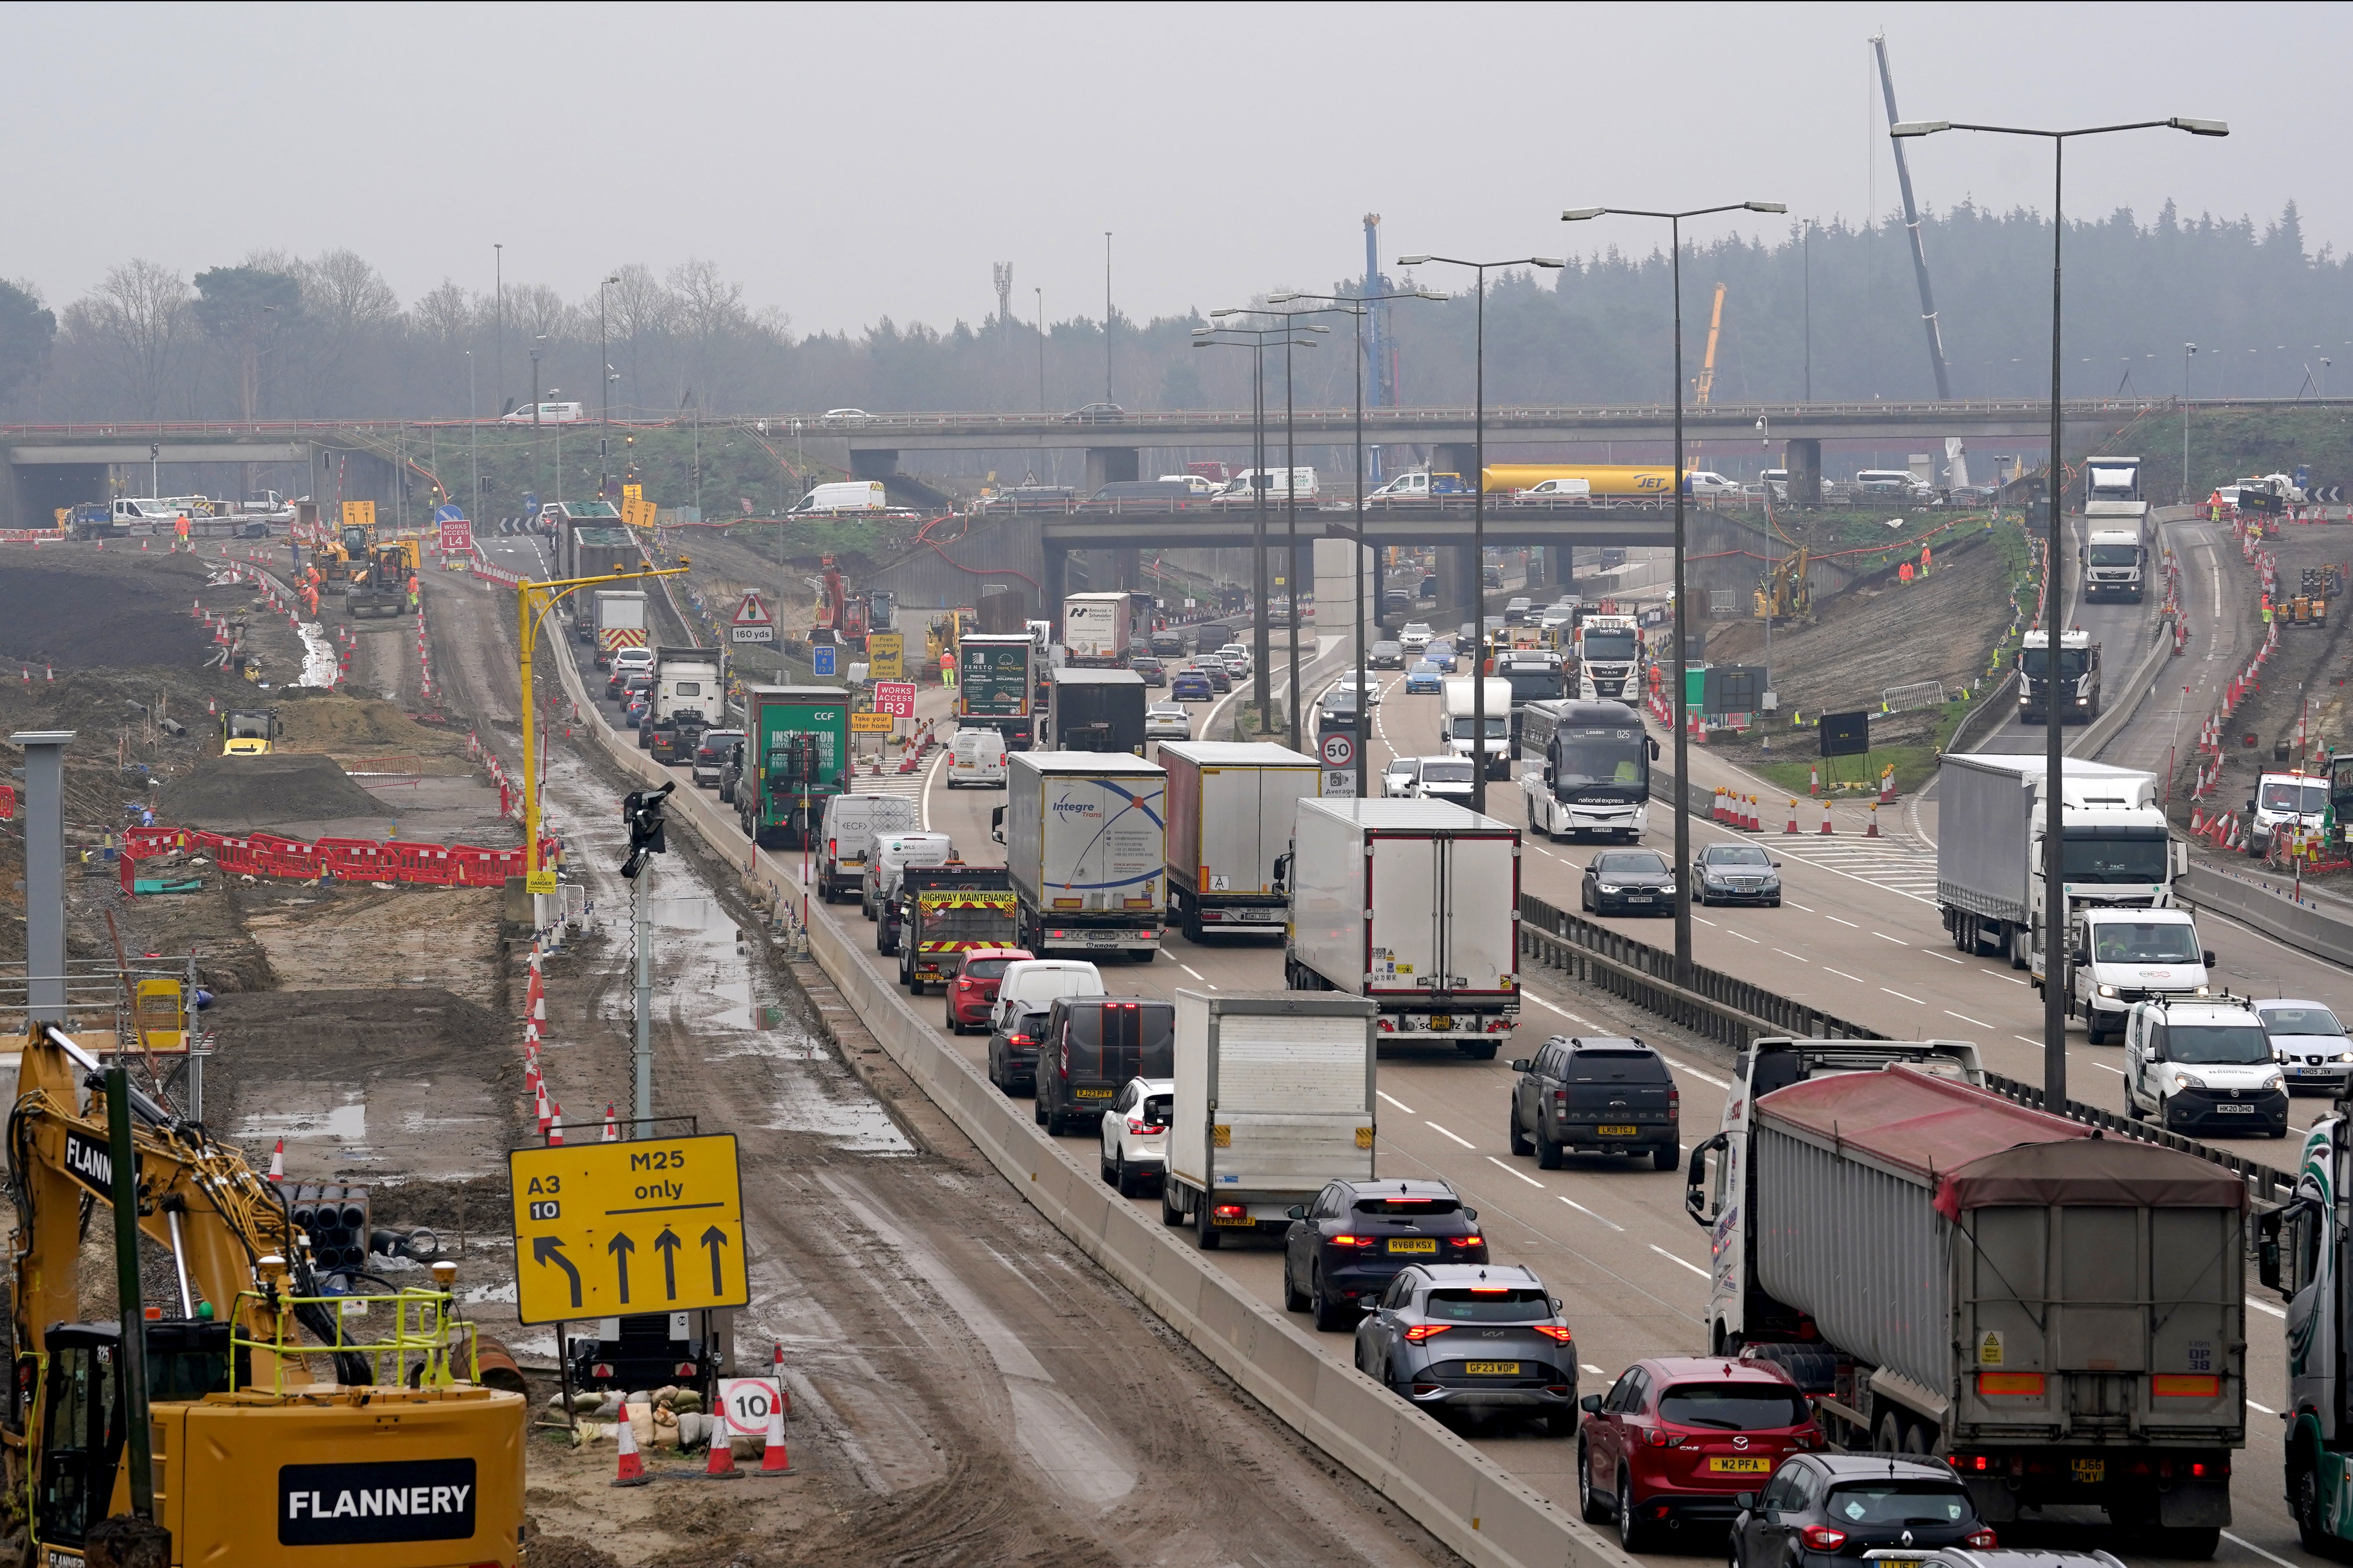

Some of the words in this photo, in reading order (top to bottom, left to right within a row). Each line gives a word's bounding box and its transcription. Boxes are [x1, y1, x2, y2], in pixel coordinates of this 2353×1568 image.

[1638, 478, 1665, 488] JET
[449, 536, 463, 546] L4
[754, 631, 769, 639] yds
[884, 703, 905, 714] B3
[1617, 730, 1630, 739] 025
[1327, 743, 1349, 757] 50
[1053, 802, 1094, 812] Integre
[1215, 878, 1224, 888] A
[959, 894, 1014, 902] MAINTENANCE
[631, 1150, 685, 1171] M25
[527, 1175, 560, 1195] A3
[634, 1179, 683, 1200] only
[533, 1202, 557, 1219] 10
[97, 1345, 109, 1363] 325
[2189, 1349, 2210, 1359] DP
[1470, 1363, 1494, 1372] GF23
[1497, 1363, 1515, 1372] WDP
[2189, 1360, 2209, 1370] 38
[736, 1395, 768, 1417] 10
[1722, 1460, 1735, 1469] M2
[1738, 1460, 1758, 1470] PFA
[2073, 1460, 2102, 1470] WJ66
[289, 1485, 471, 1519] FLANNERY
